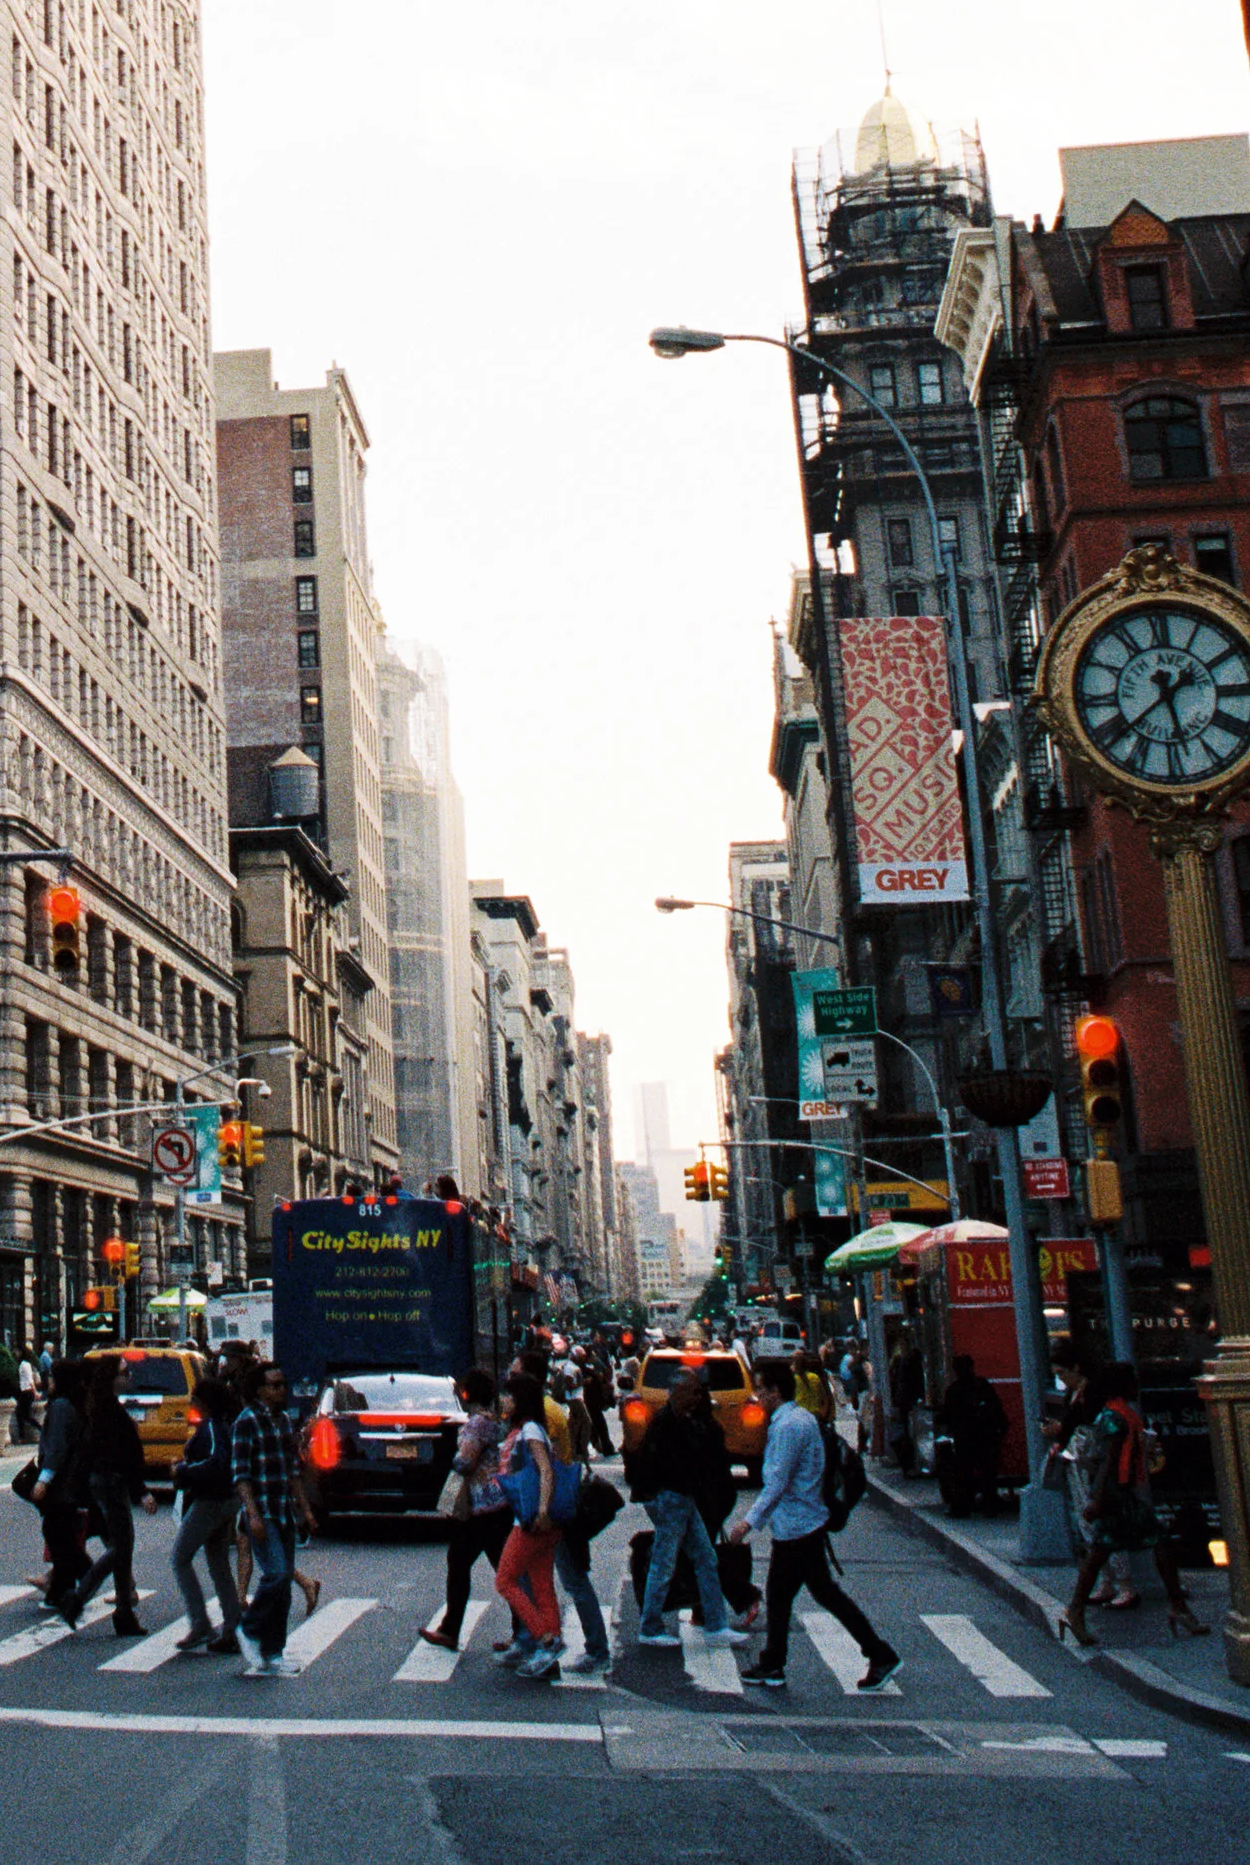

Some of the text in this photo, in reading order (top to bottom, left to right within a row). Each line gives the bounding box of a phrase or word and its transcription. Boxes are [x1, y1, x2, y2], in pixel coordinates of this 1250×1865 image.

[1121, 657, 1150, 699] FIFTH
[854, 766, 904, 812] SQ.
[875, 868, 950, 892] GREY
[816, 993, 870, 1005] West Side
[820, 1005, 868, 1018] Highway
[802, 1101, 843, 1117] GREY
[358, 1204, 382, 1217] 815
[416, 1229, 442, 1248] NY
[335, 1266, 409, 1278] 212-812-2700
[325, 1310, 421, 1322] Hop on Hop off
[1131, 1317, 1191, 1329] PURGE
